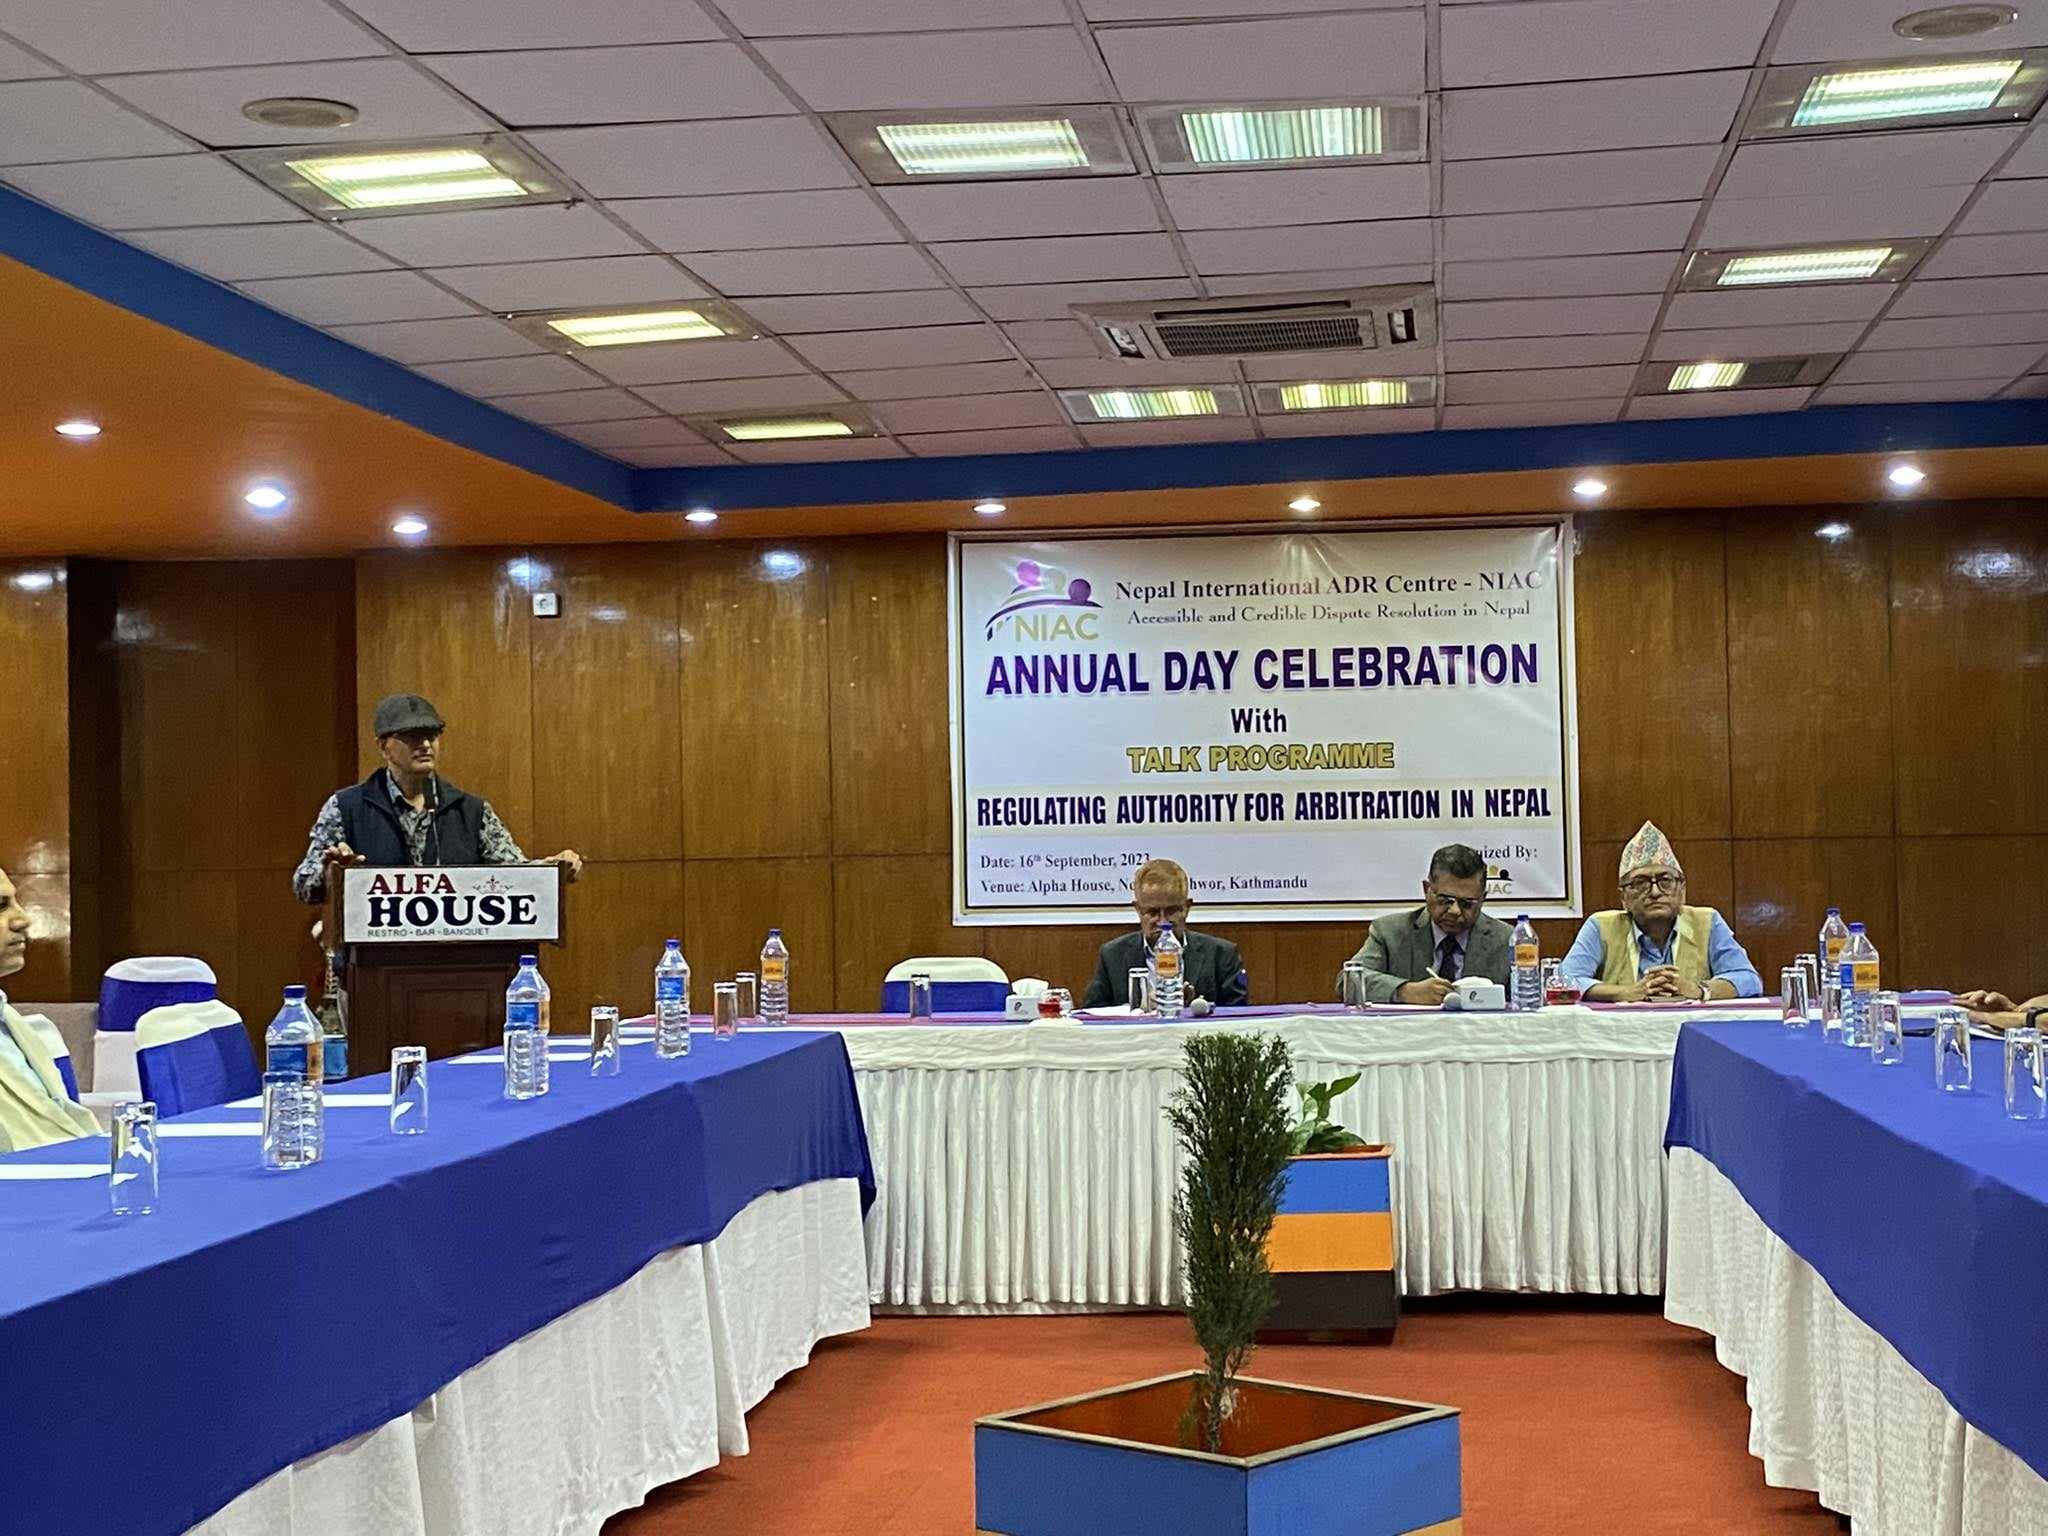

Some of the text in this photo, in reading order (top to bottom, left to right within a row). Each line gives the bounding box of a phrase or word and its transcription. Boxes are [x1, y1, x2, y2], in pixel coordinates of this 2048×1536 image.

[1116, 581, 1176, 604] Nepal
[1184, 577, 1320, 600] International
[1327, 575, 1378, 594] ADR
[1386, 574, 1457, 594] Centre
[1478, 570, 1543, 591] NIAC
[1128, 599, 1531, 625] Accessible and Credible Dispute Resolution in Nepal
[1014, 613, 1099, 642] NIAC
[986, 643, 1539, 695] ANNUAL DAY CELEBRATION
[1231, 707, 1288, 733] With
[1126, 742, 1395, 773] TALK PROGRAMME
[977, 788, 1552, 826] REGULATING AUTHORITY FOR ARBITRATION IN NEPAL
[981, 855, 1015, 869] Date:
[1045, 853, 1117, 870] September,
[1515, 845, 1538, 862] By:
[367, 873, 457, 895] ALFA
[981, 880, 1025, 893] Venue:
[1030, 880, 1067, 895] Alpha
[1071, 878, 1115, 893] House,
[1230, 876, 1308, 890] Kathmandu
[1487, 883, 1513, 895] IAC
[367, 895, 538, 928] HOUSE
[367, 927, 490, 938] RESTRO BAR BANQUET
